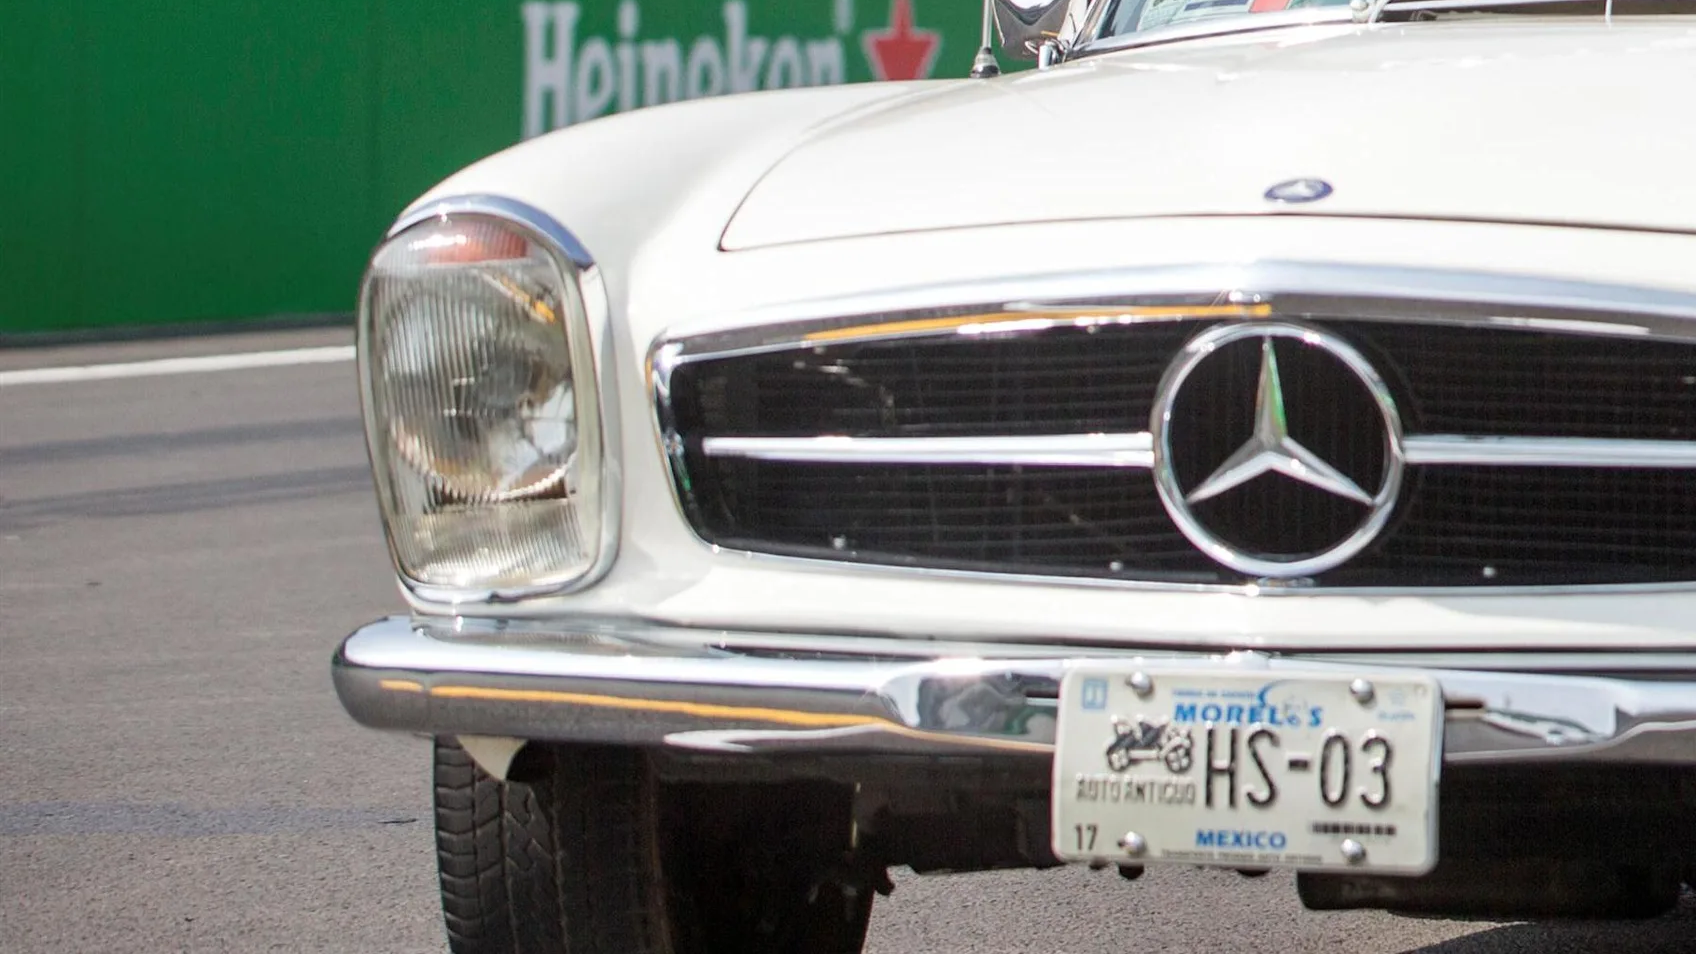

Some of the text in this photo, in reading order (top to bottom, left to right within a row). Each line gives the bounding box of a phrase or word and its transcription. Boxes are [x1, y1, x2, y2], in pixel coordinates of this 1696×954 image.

[1204, 725, 1394, 810] HS-03
[1076, 776, 1121, 803] AUTO
[1074, 822, 1098, 851] 17
[1195, 828, 1287, 850] MEXICO
